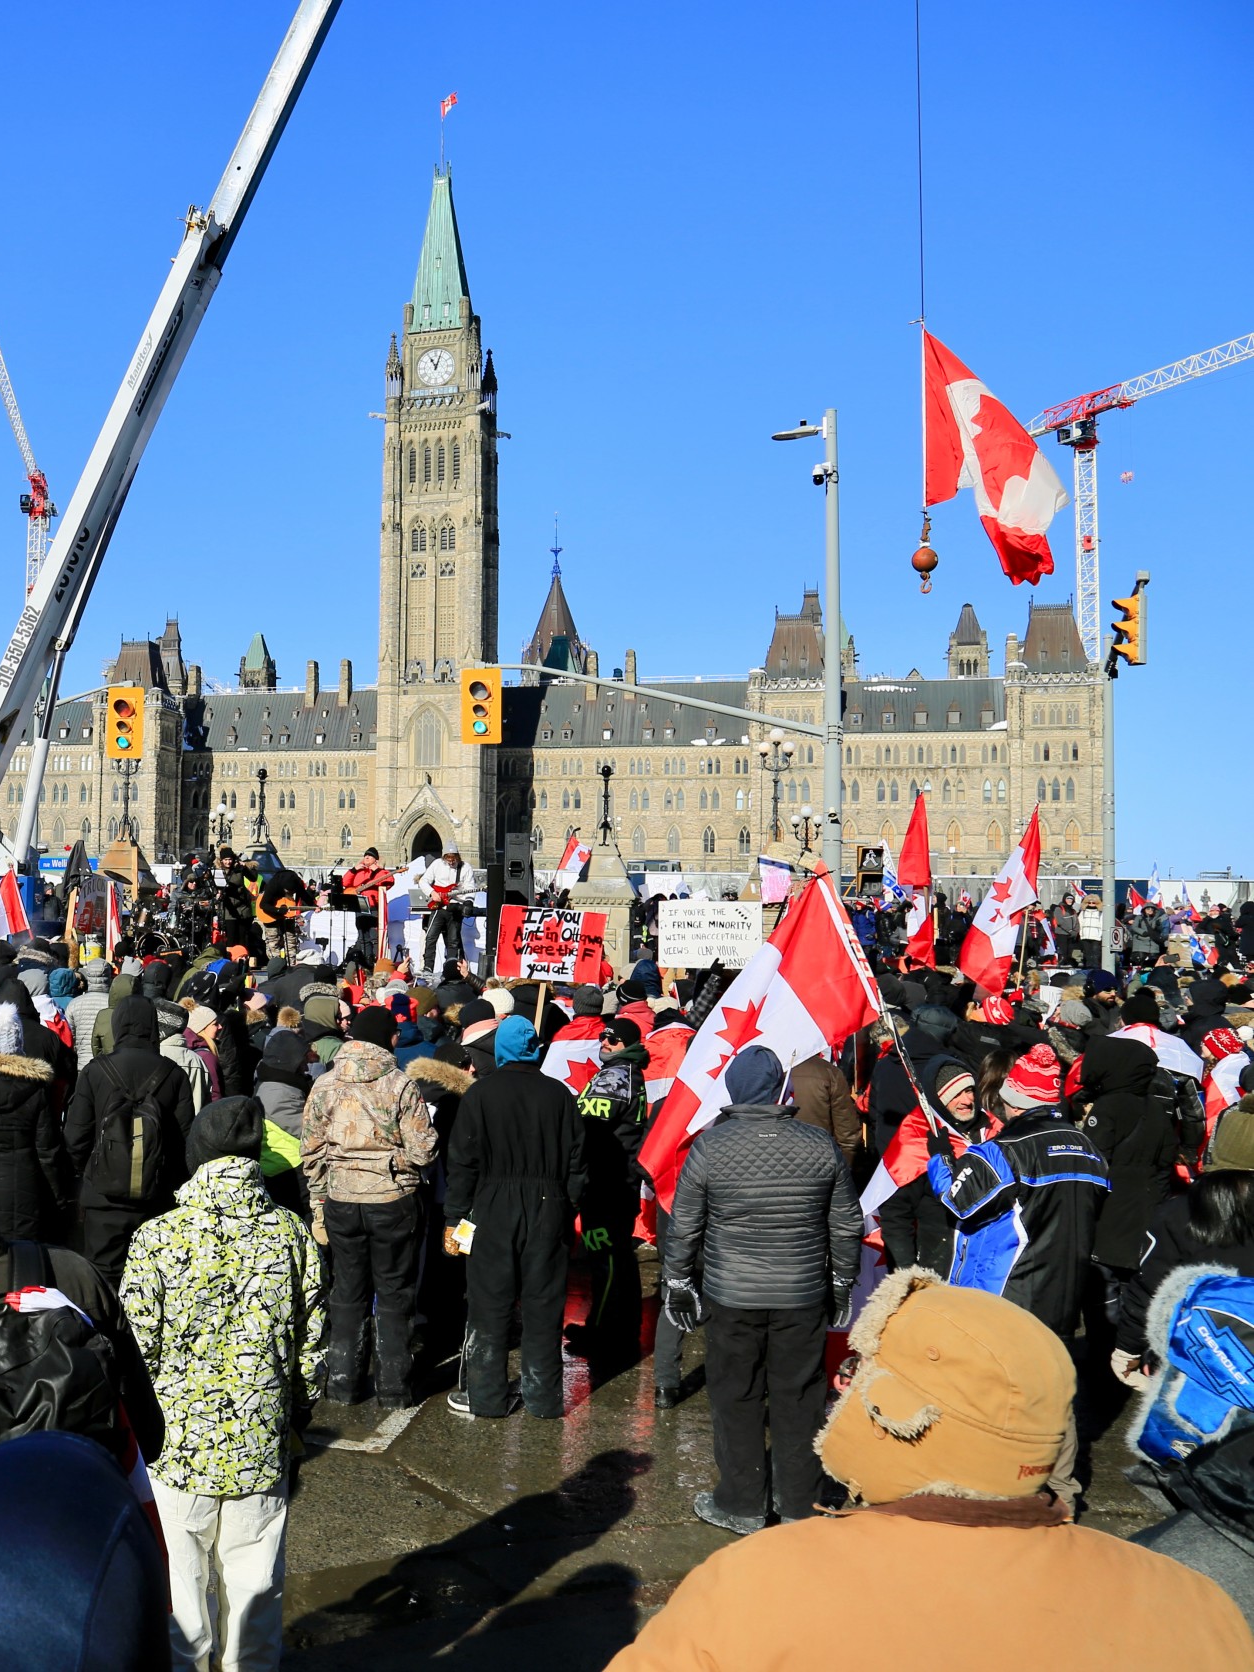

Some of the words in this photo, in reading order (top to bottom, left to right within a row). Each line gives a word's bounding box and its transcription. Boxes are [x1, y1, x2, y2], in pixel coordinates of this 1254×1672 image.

[127, 332, 153, 390] Manitex
[51, 859, 68, 868] Welli
[668, 909, 679, 917] IF
[683, 908, 706, 917] YOU'RE
[712, 908, 726, 916] THE
[672, 920, 703, 929] FRINGE
[708, 920, 752, 930] MINORITY
[546, 927, 559, 943] in
[561, 927, 603, 948] Ottawa
[665, 933, 686, 941] WITH
[691, 932, 749, 941] UNACCEPTABLE
[556, 943, 579, 957] the
[581, 947, 596, 962] F
[716, 944, 740, 957] YOUR
[527, 963, 551, 980] you
[577, 1096, 612, 1119] XR
[580, 1227, 613, 1251] XR
[1197, 1326, 1250, 1385] CHEVROLET
